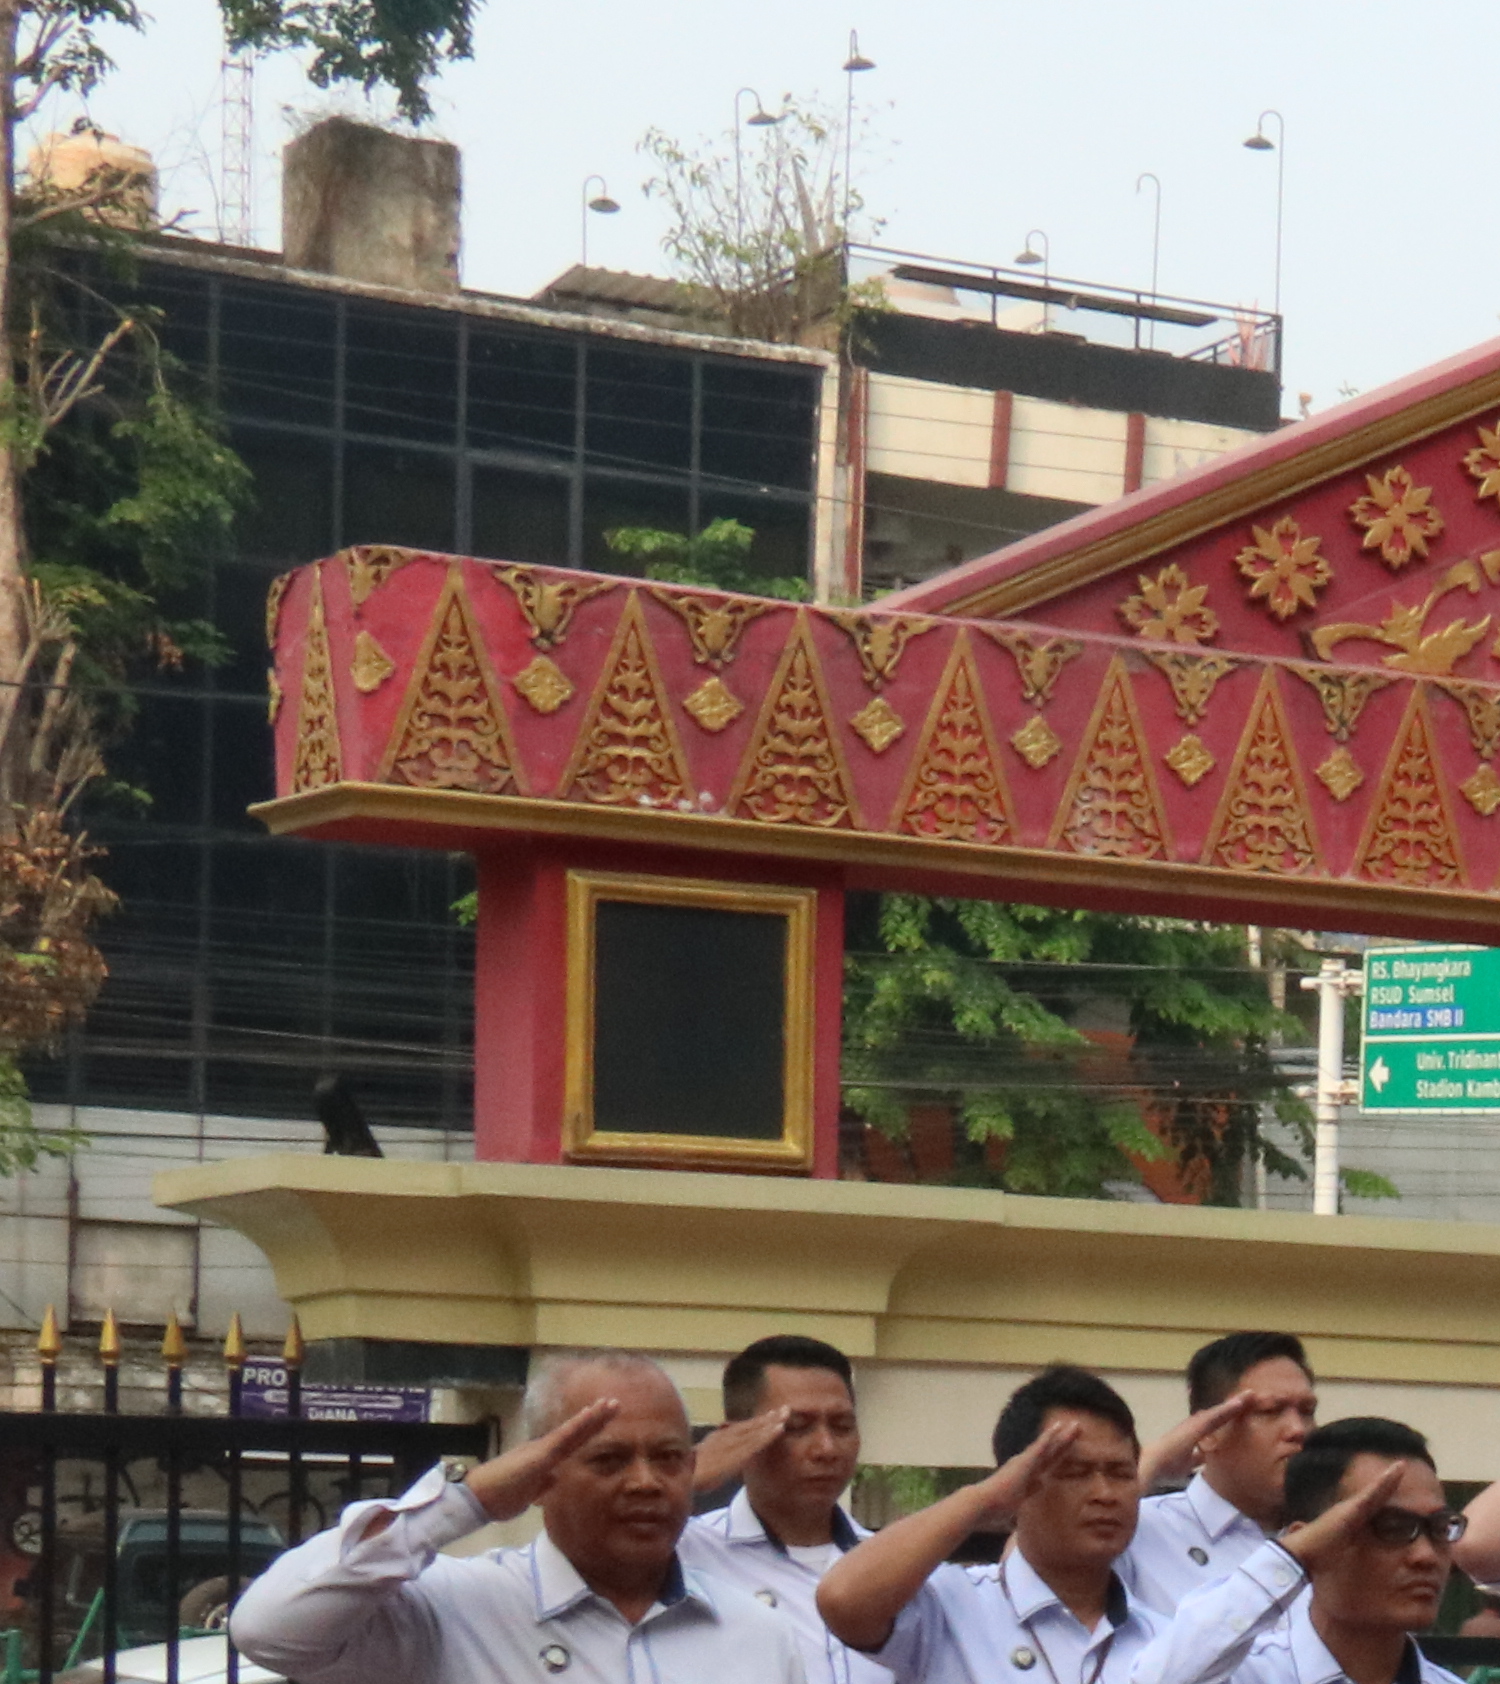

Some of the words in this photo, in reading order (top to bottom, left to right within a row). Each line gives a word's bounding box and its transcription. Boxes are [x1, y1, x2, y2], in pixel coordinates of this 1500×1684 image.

[1392, 958, 1472, 982] Bhayangkara
[1371, 986, 1403, 1004] RSUD
[1408, 984, 1455, 1003] Sumsel
[1369, 1009, 1423, 1028] Bandara
[1426, 1008, 1453, 1027] SMB
[1416, 1051, 1446, 1070] Univ.
[1416, 1078, 1463, 1098] Stadion
